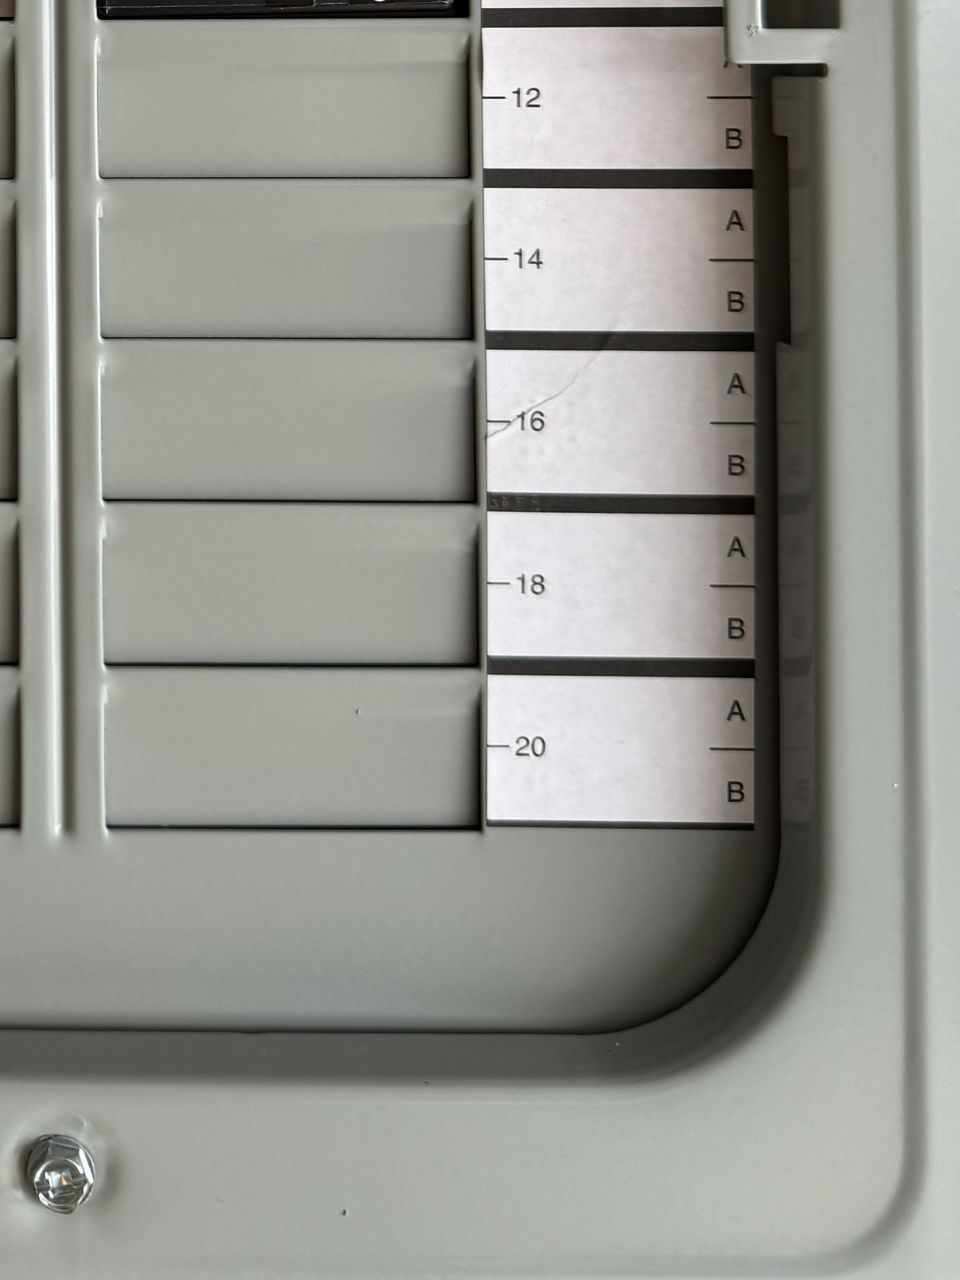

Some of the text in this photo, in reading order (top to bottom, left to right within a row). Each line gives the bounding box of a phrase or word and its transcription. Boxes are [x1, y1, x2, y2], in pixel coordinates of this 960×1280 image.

[511, 87, 541, 108] 12
[725, 127, 743, 150] B
[725, 209, 746, 232] A
[513, 248, 544, 270] 14
[727, 290, 745, 313] B
[727, 372, 747, 395] A
[517, 411, 545, 432] 16
[728, 454, 746, 477] B
[726, 536, 747, 559] A
[516, 573, 546, 596] 18
[727, 617, 746, 640] B
[726, 699, 747, 722] A
[515, 735, 546, 758] 20
[727, 781, 745, 803] B
